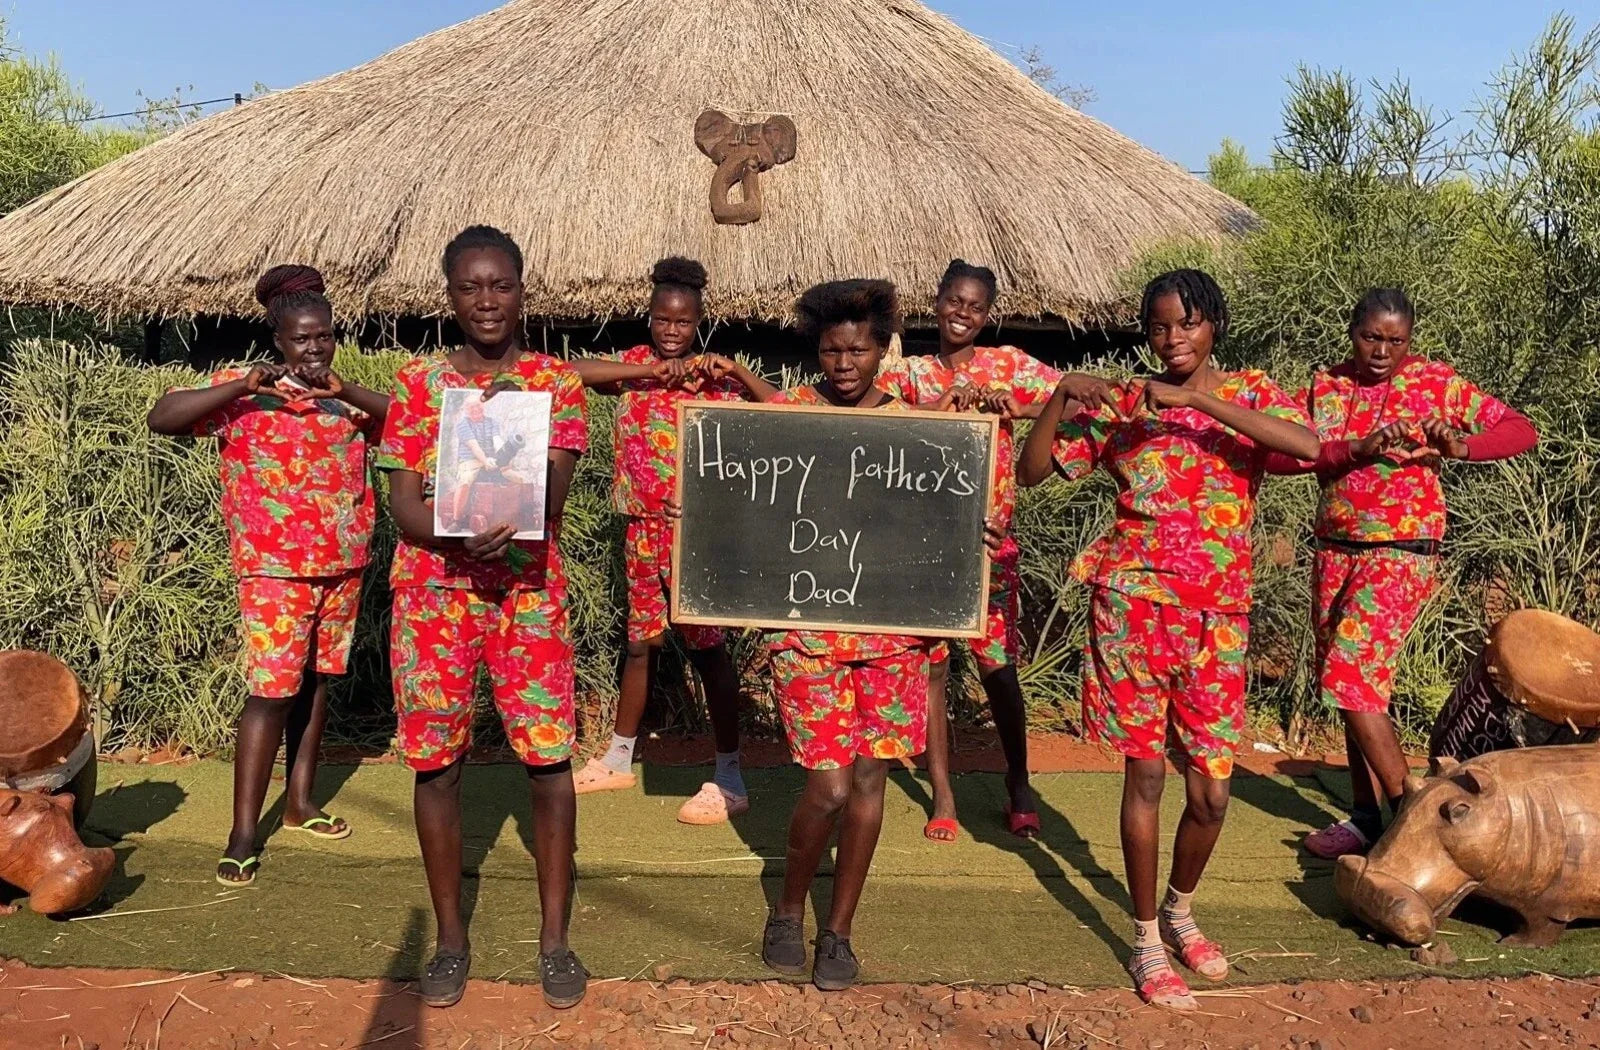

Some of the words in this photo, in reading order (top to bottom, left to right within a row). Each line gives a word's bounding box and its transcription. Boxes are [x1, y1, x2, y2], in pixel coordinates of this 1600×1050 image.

[697, 420, 816, 514] Happy
[789, 518, 862, 573] Day
[786, 562, 863, 606] Dad
